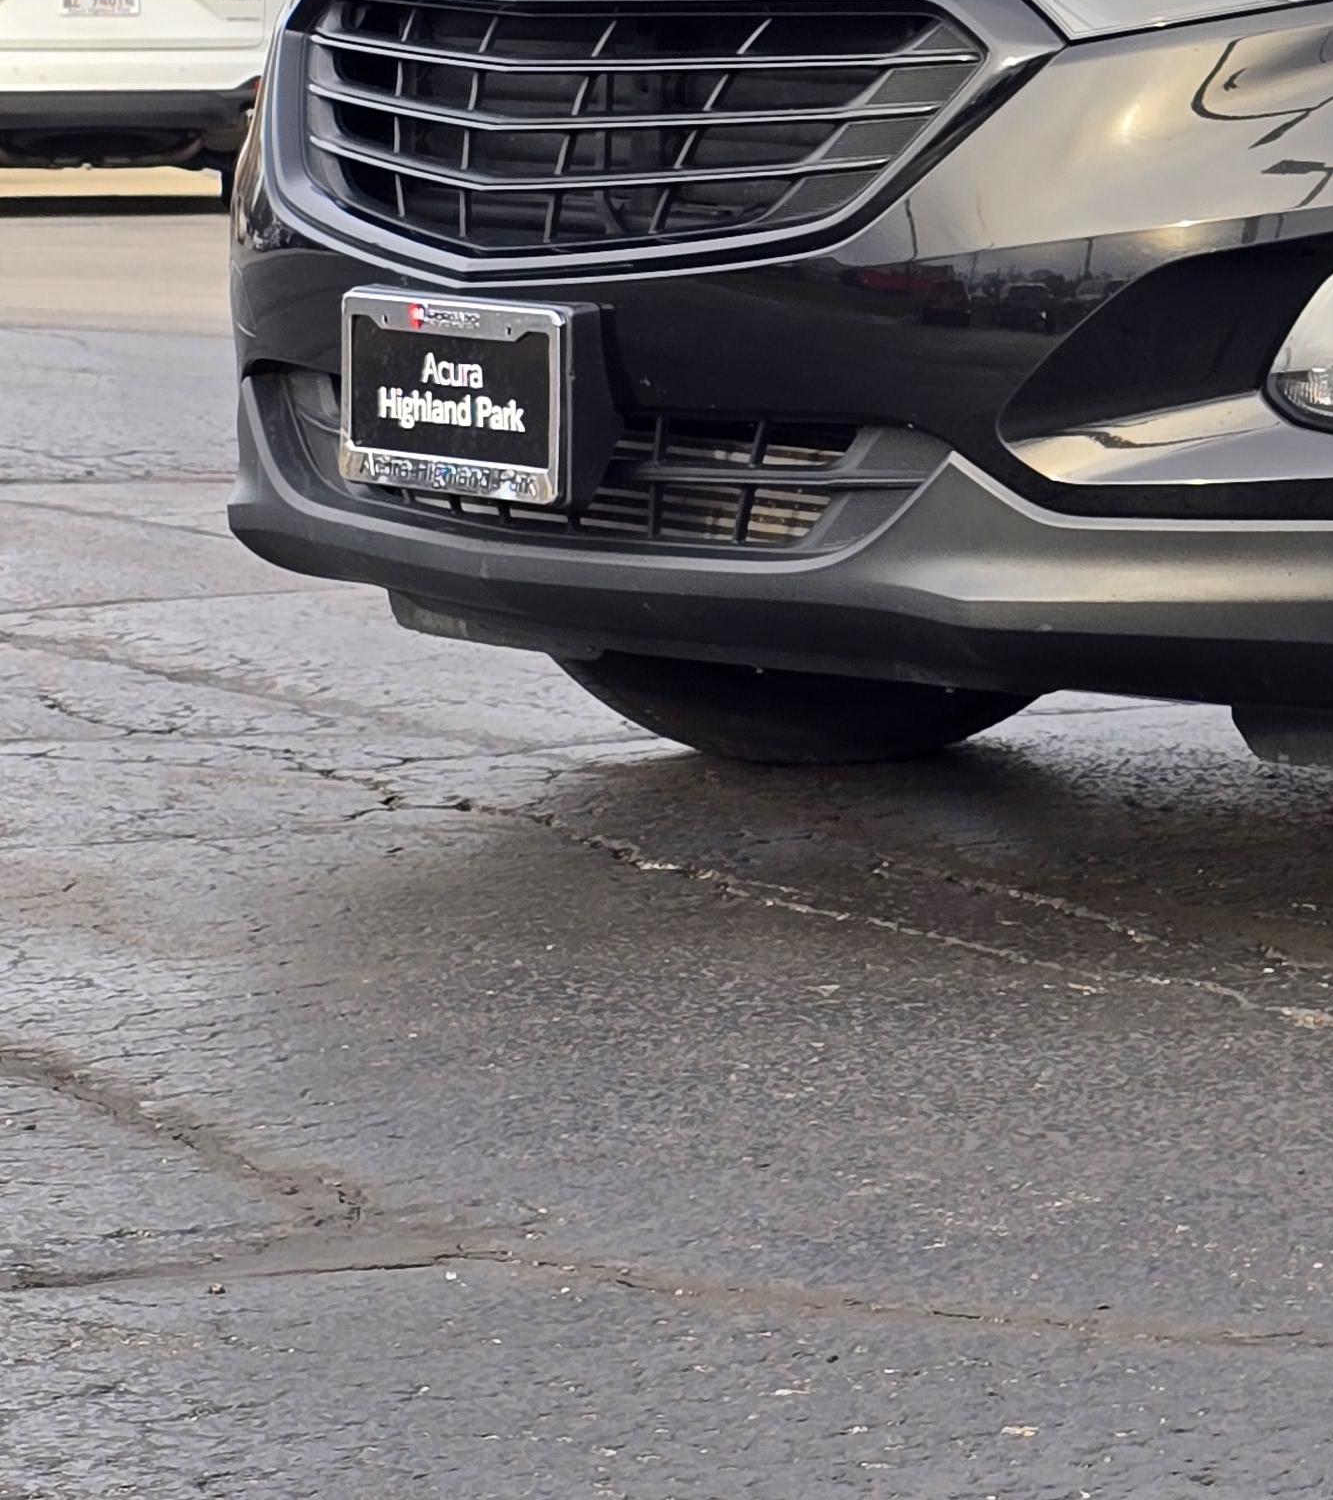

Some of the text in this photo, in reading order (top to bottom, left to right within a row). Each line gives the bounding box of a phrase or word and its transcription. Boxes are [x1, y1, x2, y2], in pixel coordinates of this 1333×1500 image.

[421, 351, 483, 389] Acura
[377, 386, 526, 432] Highland Park
